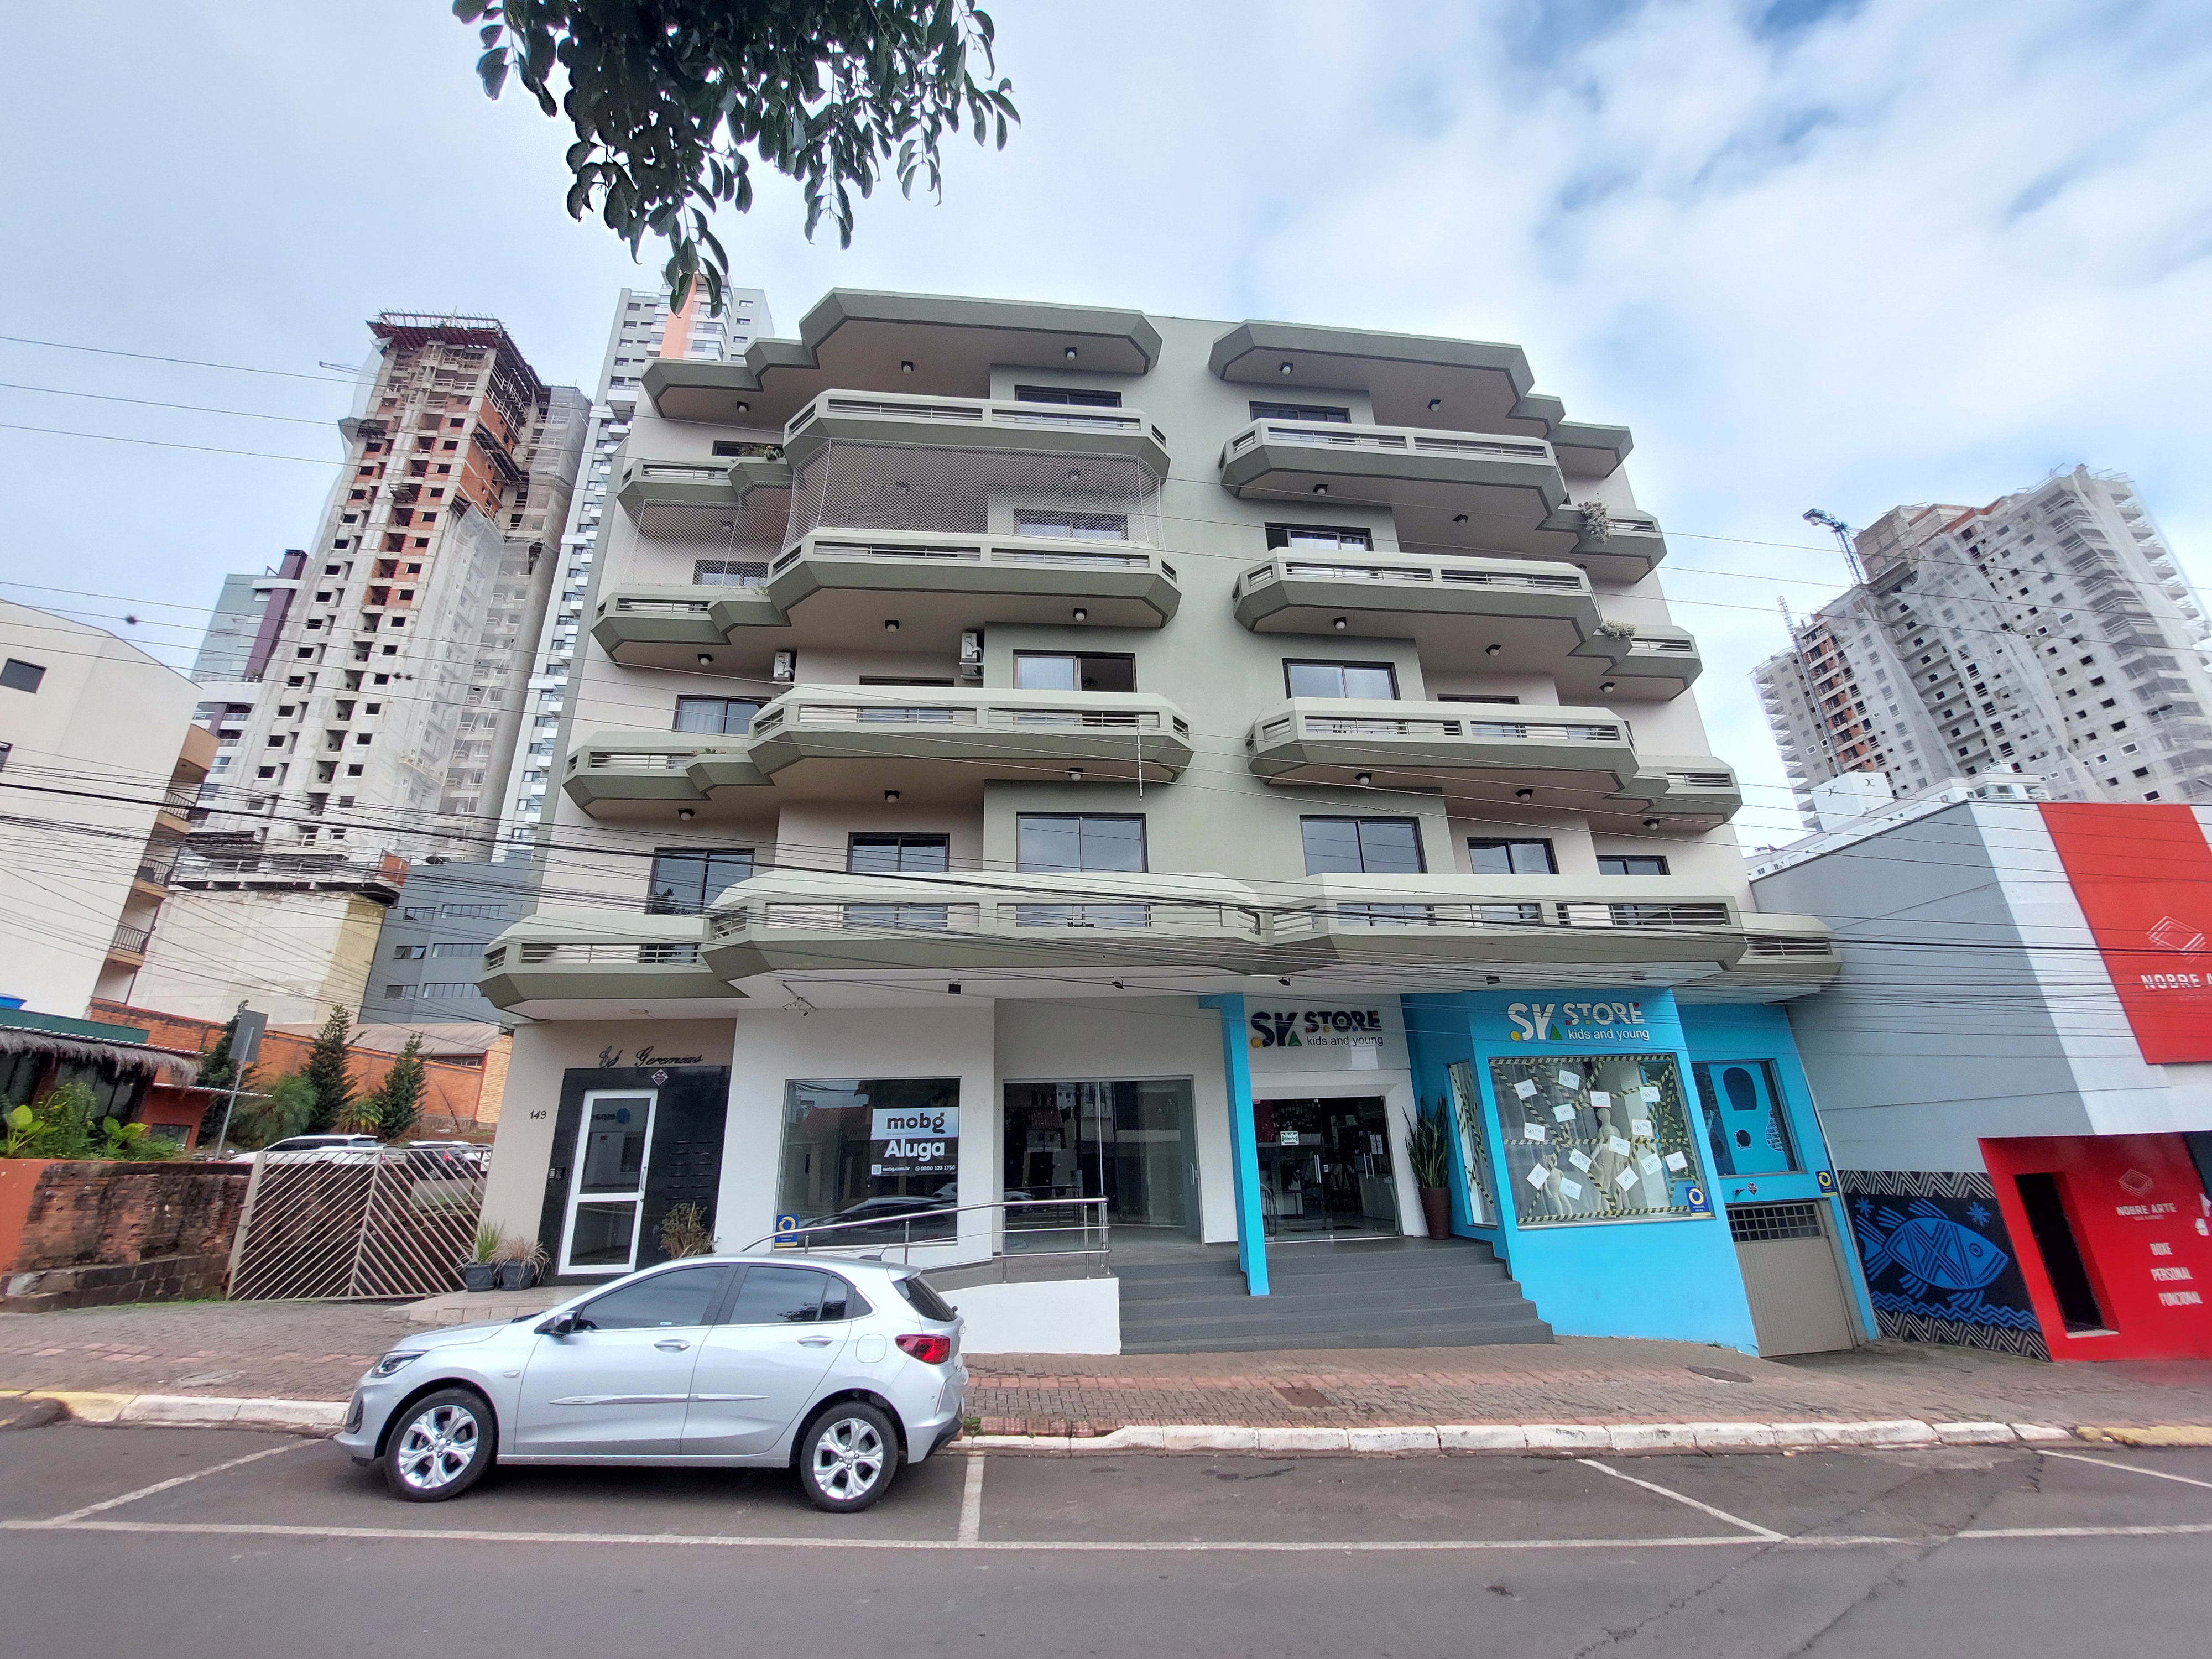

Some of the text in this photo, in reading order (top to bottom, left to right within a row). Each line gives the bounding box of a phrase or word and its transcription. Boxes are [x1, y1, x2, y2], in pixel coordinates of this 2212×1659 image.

[2140, 973, 2201, 989] NOBRE
[1305, 1011, 1382, 1032] STORE
[1563, 1002, 1645, 1026] STORE
[1307, 1036, 1383, 1047] kids and young
[1568, 1029, 1649, 1041] kids and young
[530, 1109, 547, 1120] 149
[887, 1112, 946, 1134] mobg
[884, 1139, 945, 1162] Aluga
[2115, 1203, 2177, 1216] NOBRE ARTE
[2150, 1242, 2173, 1256] BOXE
[2150, 1266, 2194, 1282] PERSONAL
[2158, 1291, 2203, 1307] FUNCIONAL
